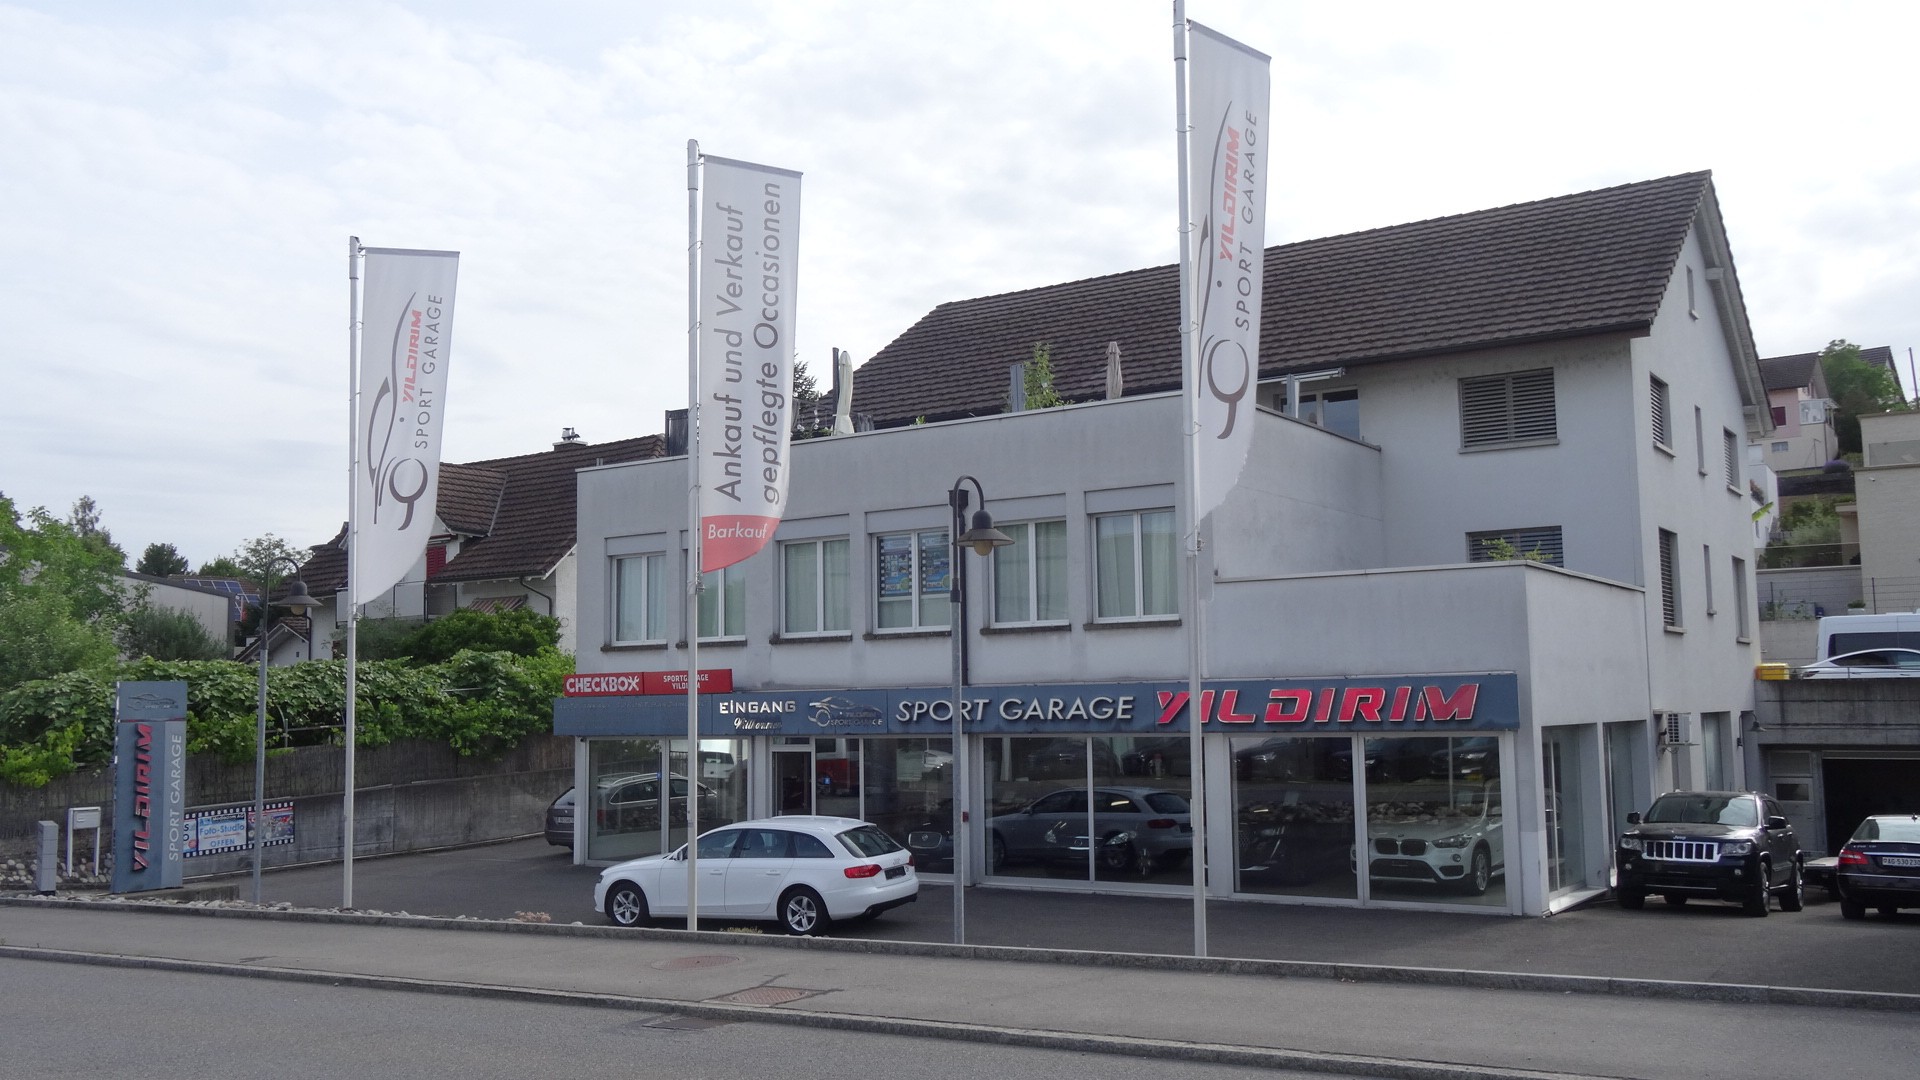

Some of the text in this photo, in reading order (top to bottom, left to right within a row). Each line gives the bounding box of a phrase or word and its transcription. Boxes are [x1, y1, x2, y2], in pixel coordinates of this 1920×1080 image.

[1219, 126, 1240, 263] YILDIRIM
[1235, 110, 1257, 331] SPORT GARAGE
[401, 309, 422, 403] YILDIRIM
[415, 294, 443, 449] SPORT GARAGE
[712, 202, 744, 503] Ankauf und Verkauf
[752, 182, 784, 506] gepflegte Occasionen
[707, 522, 768, 541] Barkauf
[566, 676, 640, 693] CHECKBOX
[663, 674, 709, 682] SPORTGAGE
[896, 696, 1134, 722] SPORT GARAGE
[1156, 683, 1480, 724] YILDIRIM
[133, 723, 153, 871] YILDIRIM
[169, 735, 182, 861] SPORT GARAGE
[200, 823, 245, 835] Foto-Studio
[210, 838, 235, 847] OFFEN
